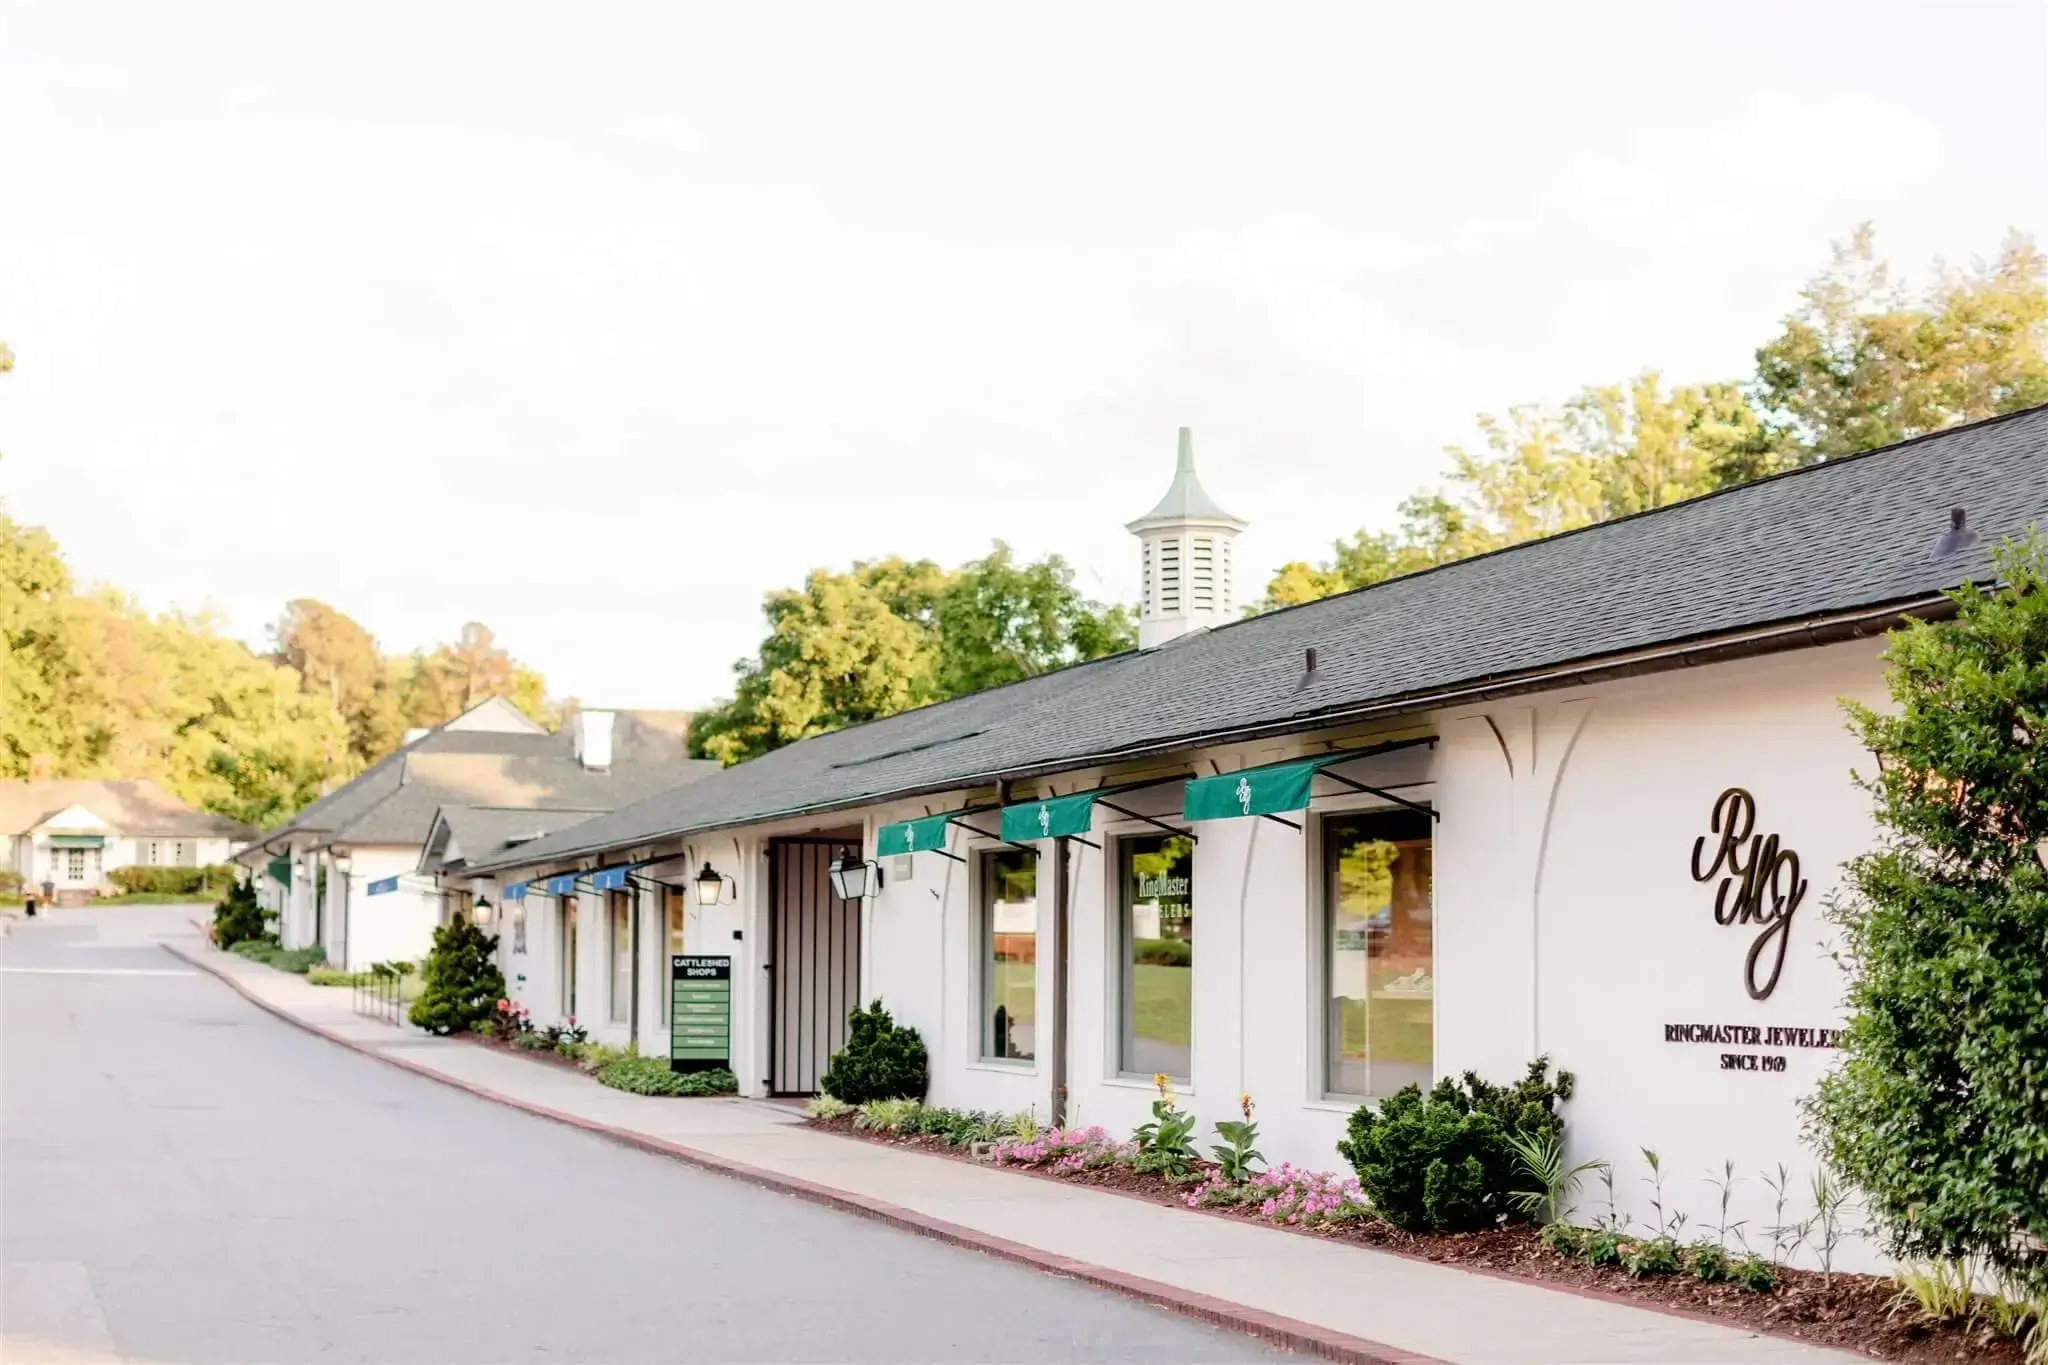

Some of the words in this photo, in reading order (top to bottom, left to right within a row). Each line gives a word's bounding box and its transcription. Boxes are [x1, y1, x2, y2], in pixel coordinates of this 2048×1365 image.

[1139, 870, 1189, 899] RingMaster
[674, 959, 730, 967] CATTLESHED
[687, 968, 717, 976] SHOPS
[1664, 1023, 1761, 1045] RINGMASTER
[1720, 1054, 1758, 1071] SINCE
